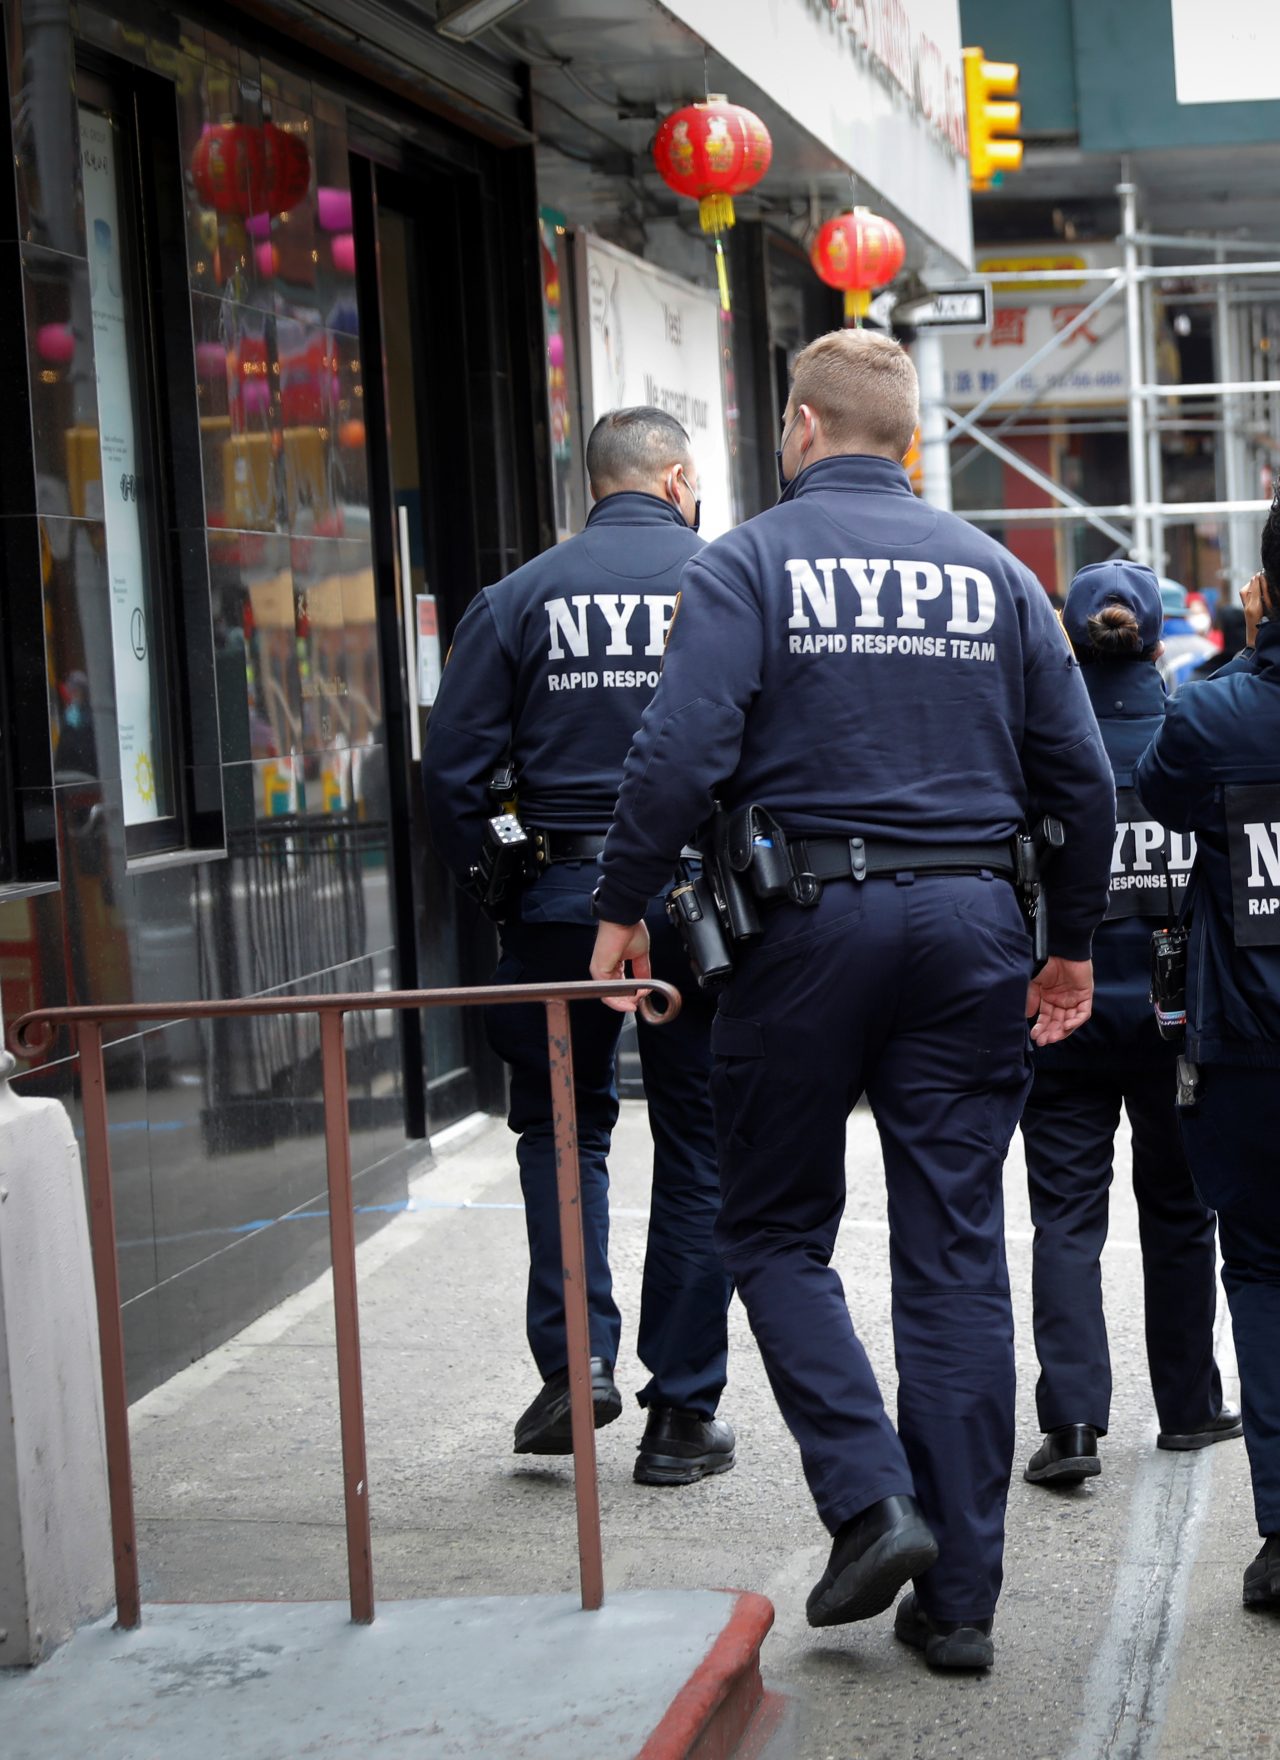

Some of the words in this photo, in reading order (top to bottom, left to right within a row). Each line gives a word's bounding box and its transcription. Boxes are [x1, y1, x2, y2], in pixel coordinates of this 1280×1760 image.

[785, 558, 996, 635] NYPD
[544, 594, 677, 660] NYP
[789, 634, 847, 654] RAPID
[851, 634, 946, 657] RESPONSE
[950, 639, 995, 662] TEAM
[548, 672, 598, 691] RAPID
[603, 671, 662, 687] RESPO
[1110, 821, 1197, 873] YPD
[1170, 873, 1191, 888] TE
